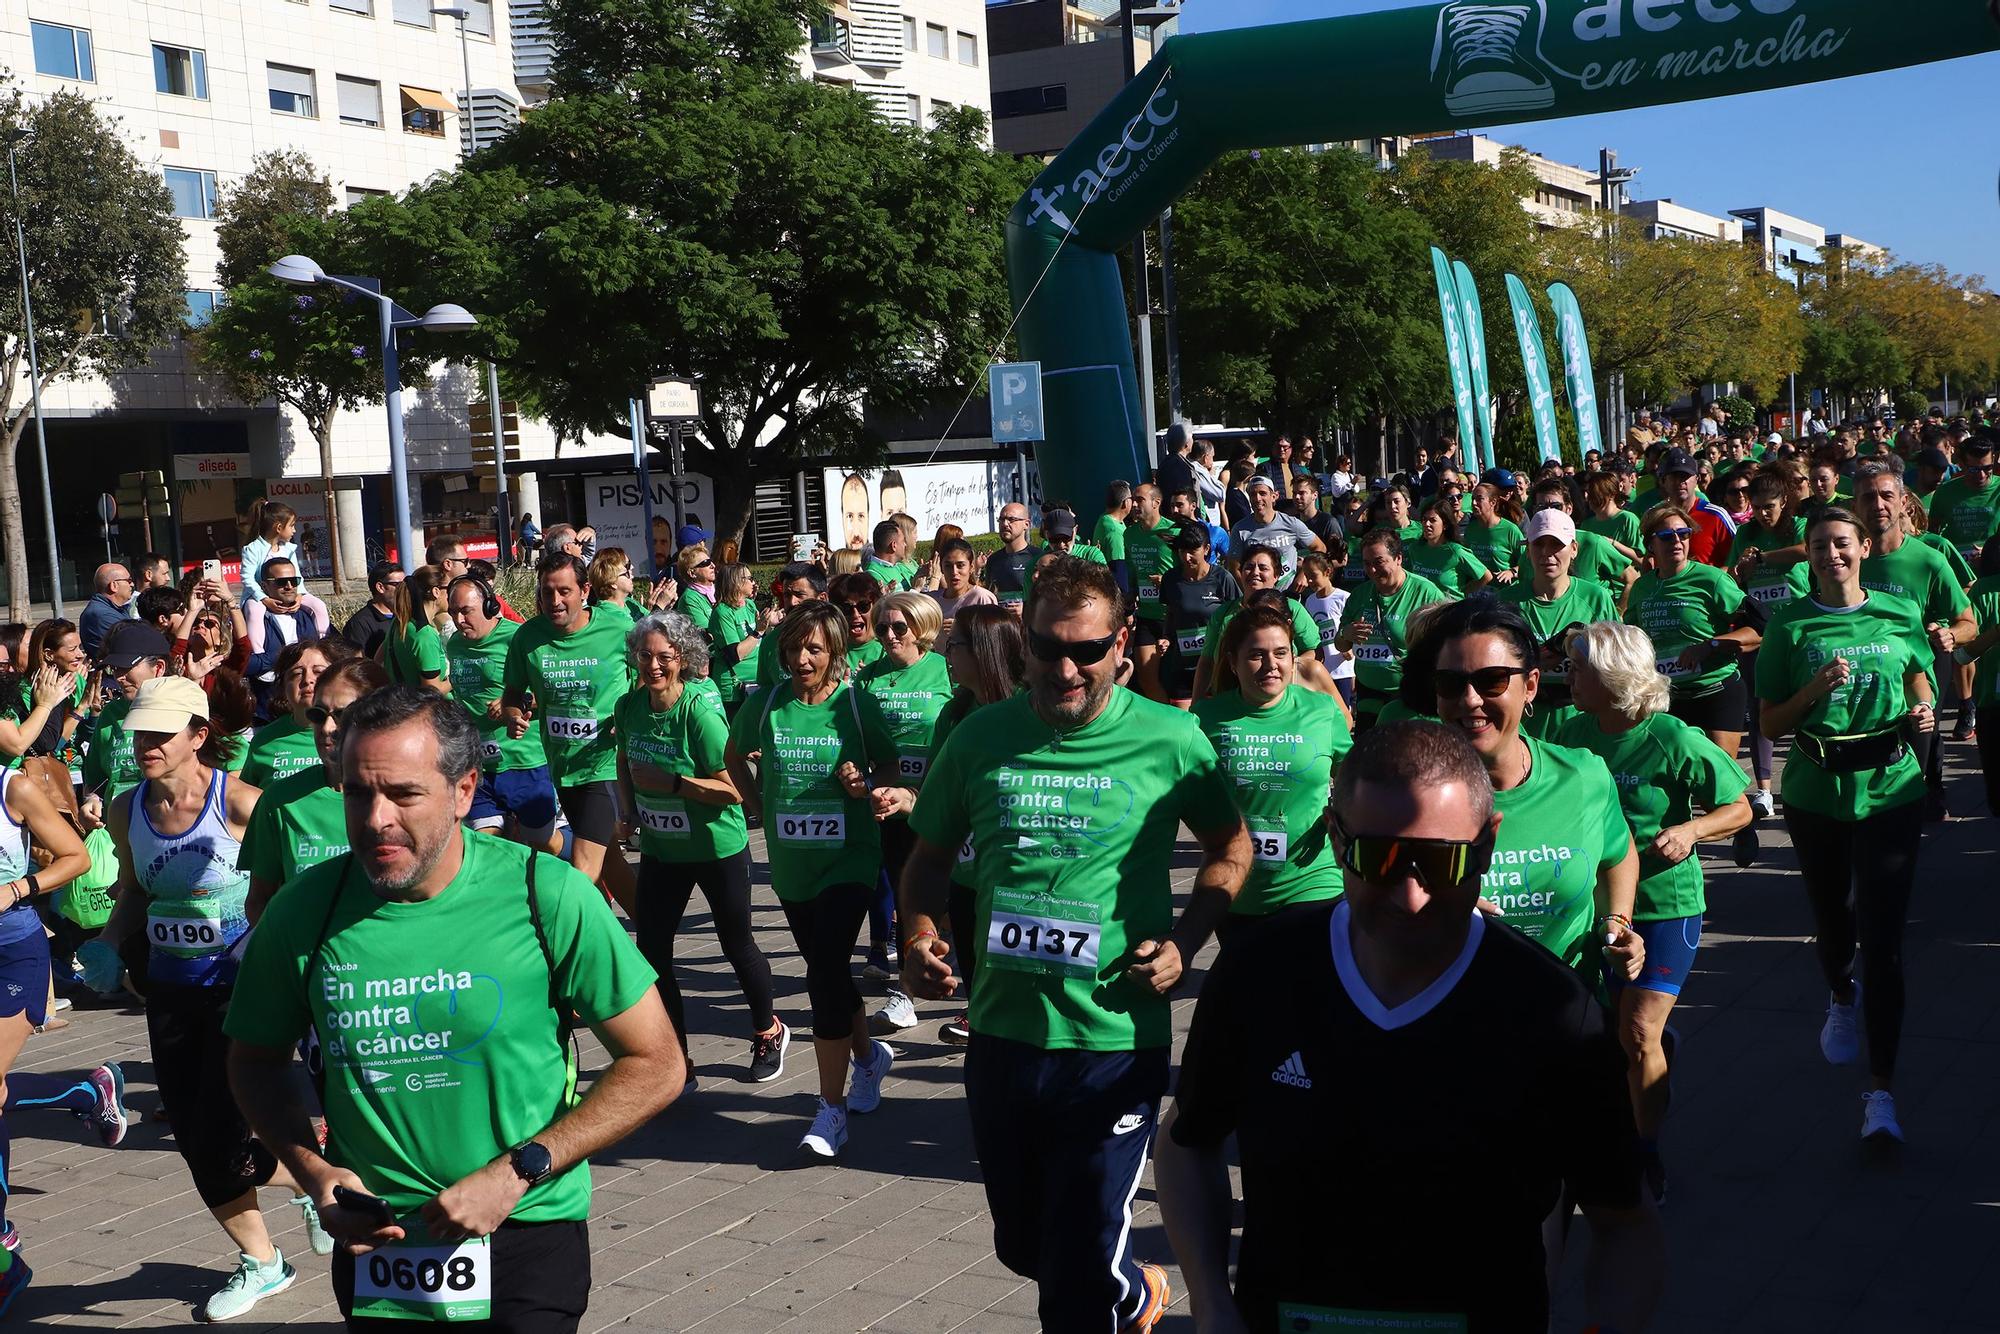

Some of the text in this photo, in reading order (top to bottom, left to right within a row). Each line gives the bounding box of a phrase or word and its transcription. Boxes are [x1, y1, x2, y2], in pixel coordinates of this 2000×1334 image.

[1572, 0, 1799, 41] ae
[1580, 14, 1852, 90] en marcha
[1072, 87, 1179, 204] aecc
[1107, 127, 1180, 203] Contra el Cáncer
[1003, 373, 1026, 405] P
[198, 457, 237, 473] aliseda
[270, 483, 302, 496] LOCAL
[1142, 588, 1158, 597] 003
[1753, 587, 1786, 601] 0167
[1641, 609, 1668, 618] contra
[1356, 646, 1389, 659] 0184
[1832, 643, 1890, 657] marcha
[542, 656, 598, 668] En marcha
[542, 669, 576, 678] contra
[555, 679, 591, 689] cáncer
[891, 690, 932, 699] marcha
[880, 700, 908, 709] ontra
[551, 720, 592, 736] 0164
[628, 736, 677, 755] En marcha
[774, 733, 843, 746] En marcha
[1245, 733, 1303, 744] marcha
[627, 749, 653, 763] contra
[773, 747, 813, 759] contra
[1221, 745, 1269, 757] contra
[273, 755, 324, 767] En marc
[773, 760, 832, 772] el cáncer
[1236, 758, 1291, 771] cáncer
[998, 773, 1111, 789] En marcha
[998, 791, 1063, 808] contra
[641, 809, 684, 829] 0170
[1000, 811, 1092, 829] el cáncer
[783, 819, 839, 836] 0172
[297, 843, 318, 858] En
[1481, 869, 1522, 887] ntra
[90, 892, 115, 912] GRE
[997, 890, 1021, 899] Córdoba
[153, 922, 215, 944] 0190
[1000, 922, 1090, 958] 0137
[323, 968, 473, 1001] En marcha
[326, 1004, 411, 1029] contra
[329, 1030, 452, 1057] el cáncer
[389, 1057, 412, 1066] CONTRA
[413, 1056, 421, 1064] EL
[421, 1054, 444, 1063] CÁNCER
[1271, 1070, 1313, 1089] adidas
[1119, 1114, 1143, 1127] NIKE
[369, 1255, 476, 1293] 0608
[1325, 1313, 1336, 1323] En
[1340, 1315, 1376, 1327] Marcha
[1376, 1318, 1411, 1329] Contra
[1411, 1319, 1422, 1328] el
